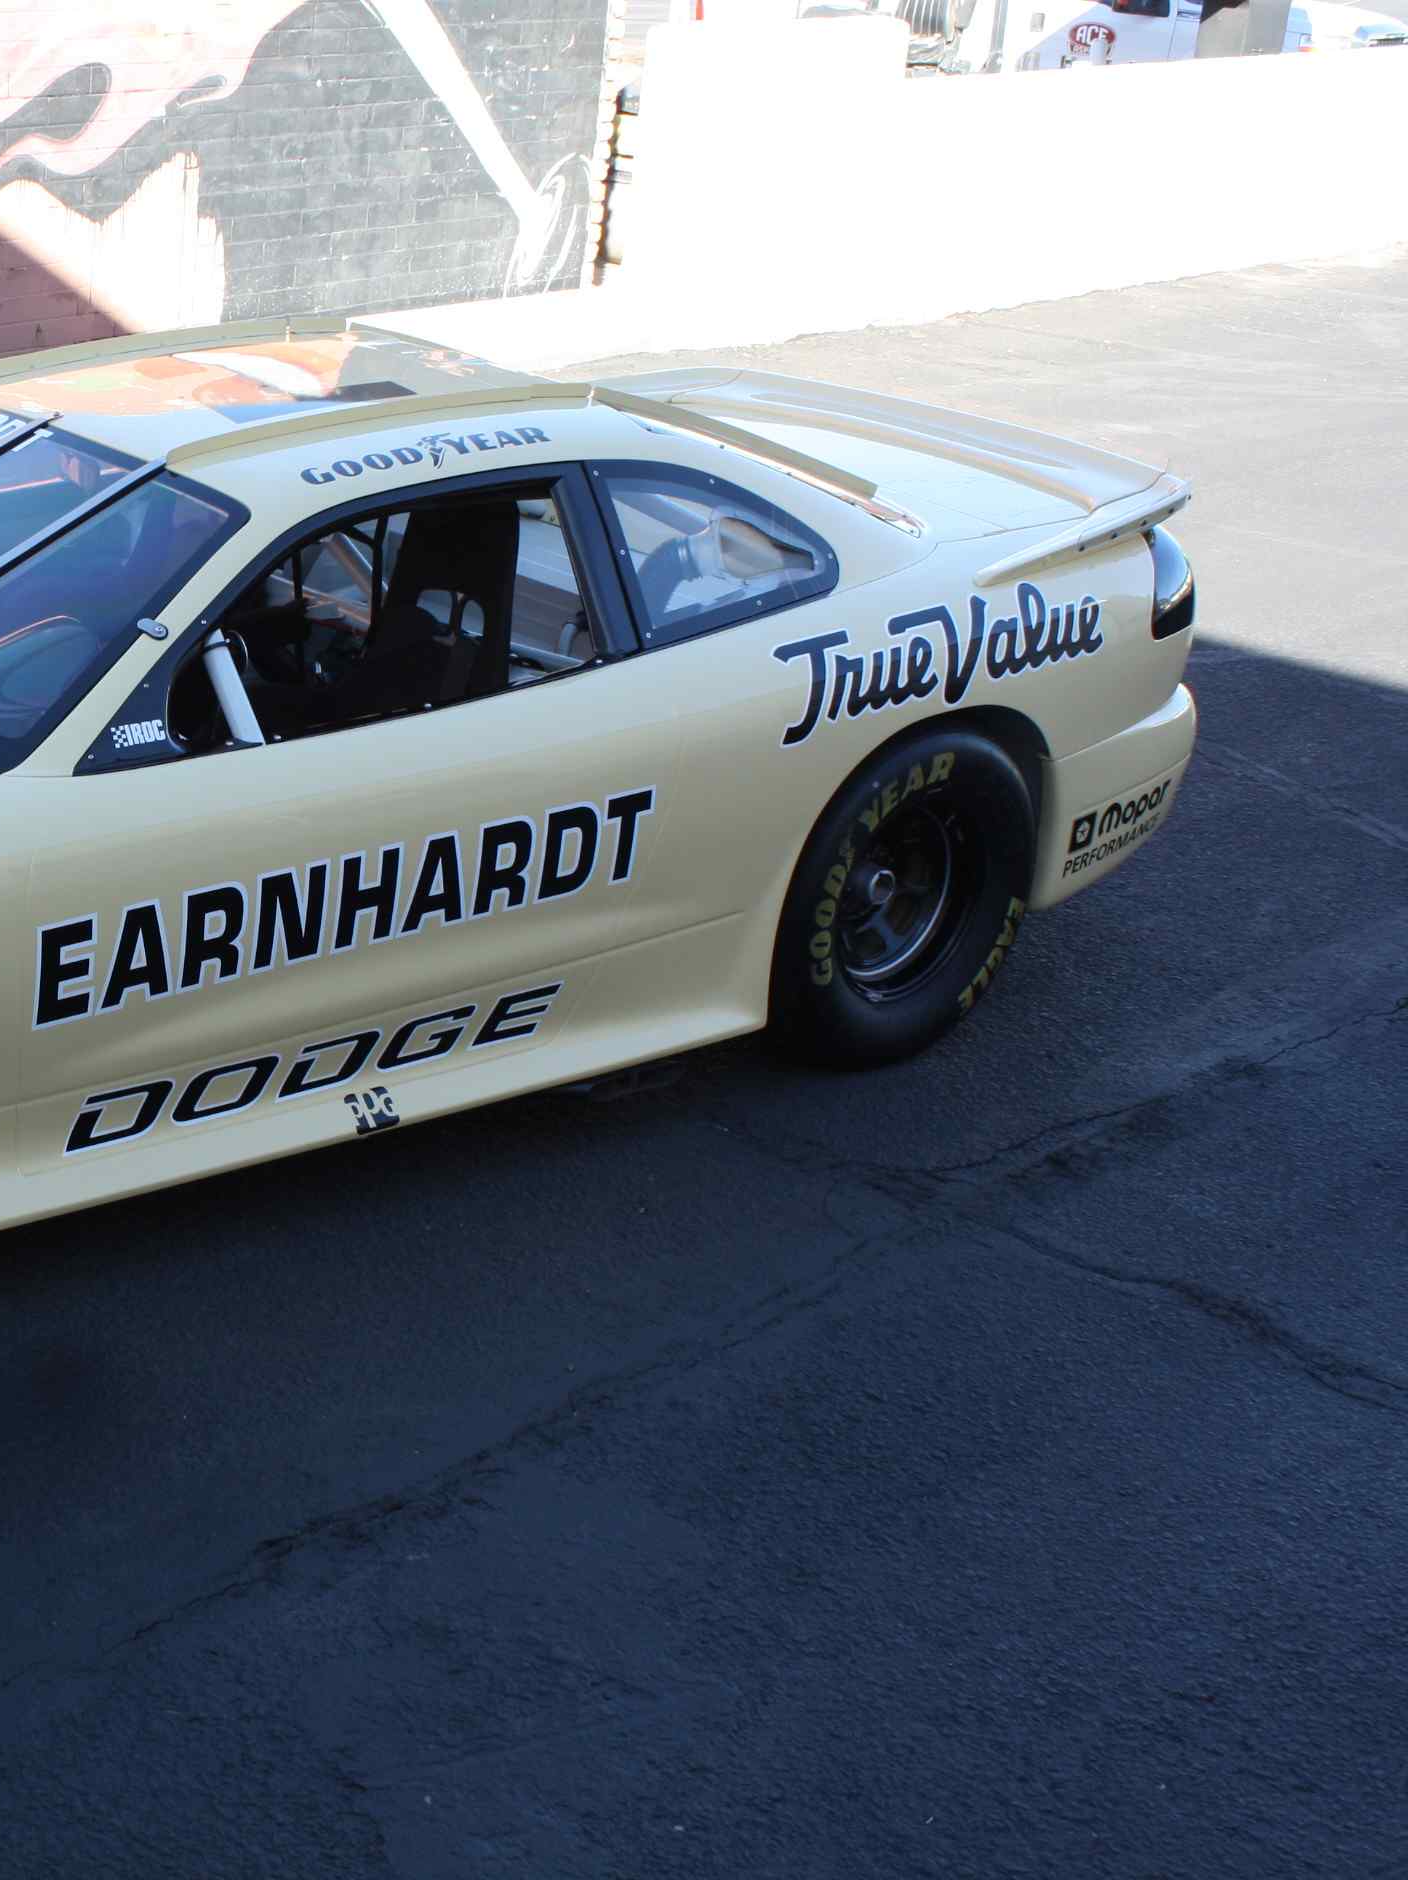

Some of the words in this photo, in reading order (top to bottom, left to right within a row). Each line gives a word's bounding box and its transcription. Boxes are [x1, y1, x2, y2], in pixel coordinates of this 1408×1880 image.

[1075, 25, 1109, 45] ACE
[124, 719, 167, 747] IROC
[31, 785, 657, 1030] EARNHARDT
[62, 979, 566, 1157] DODGE
